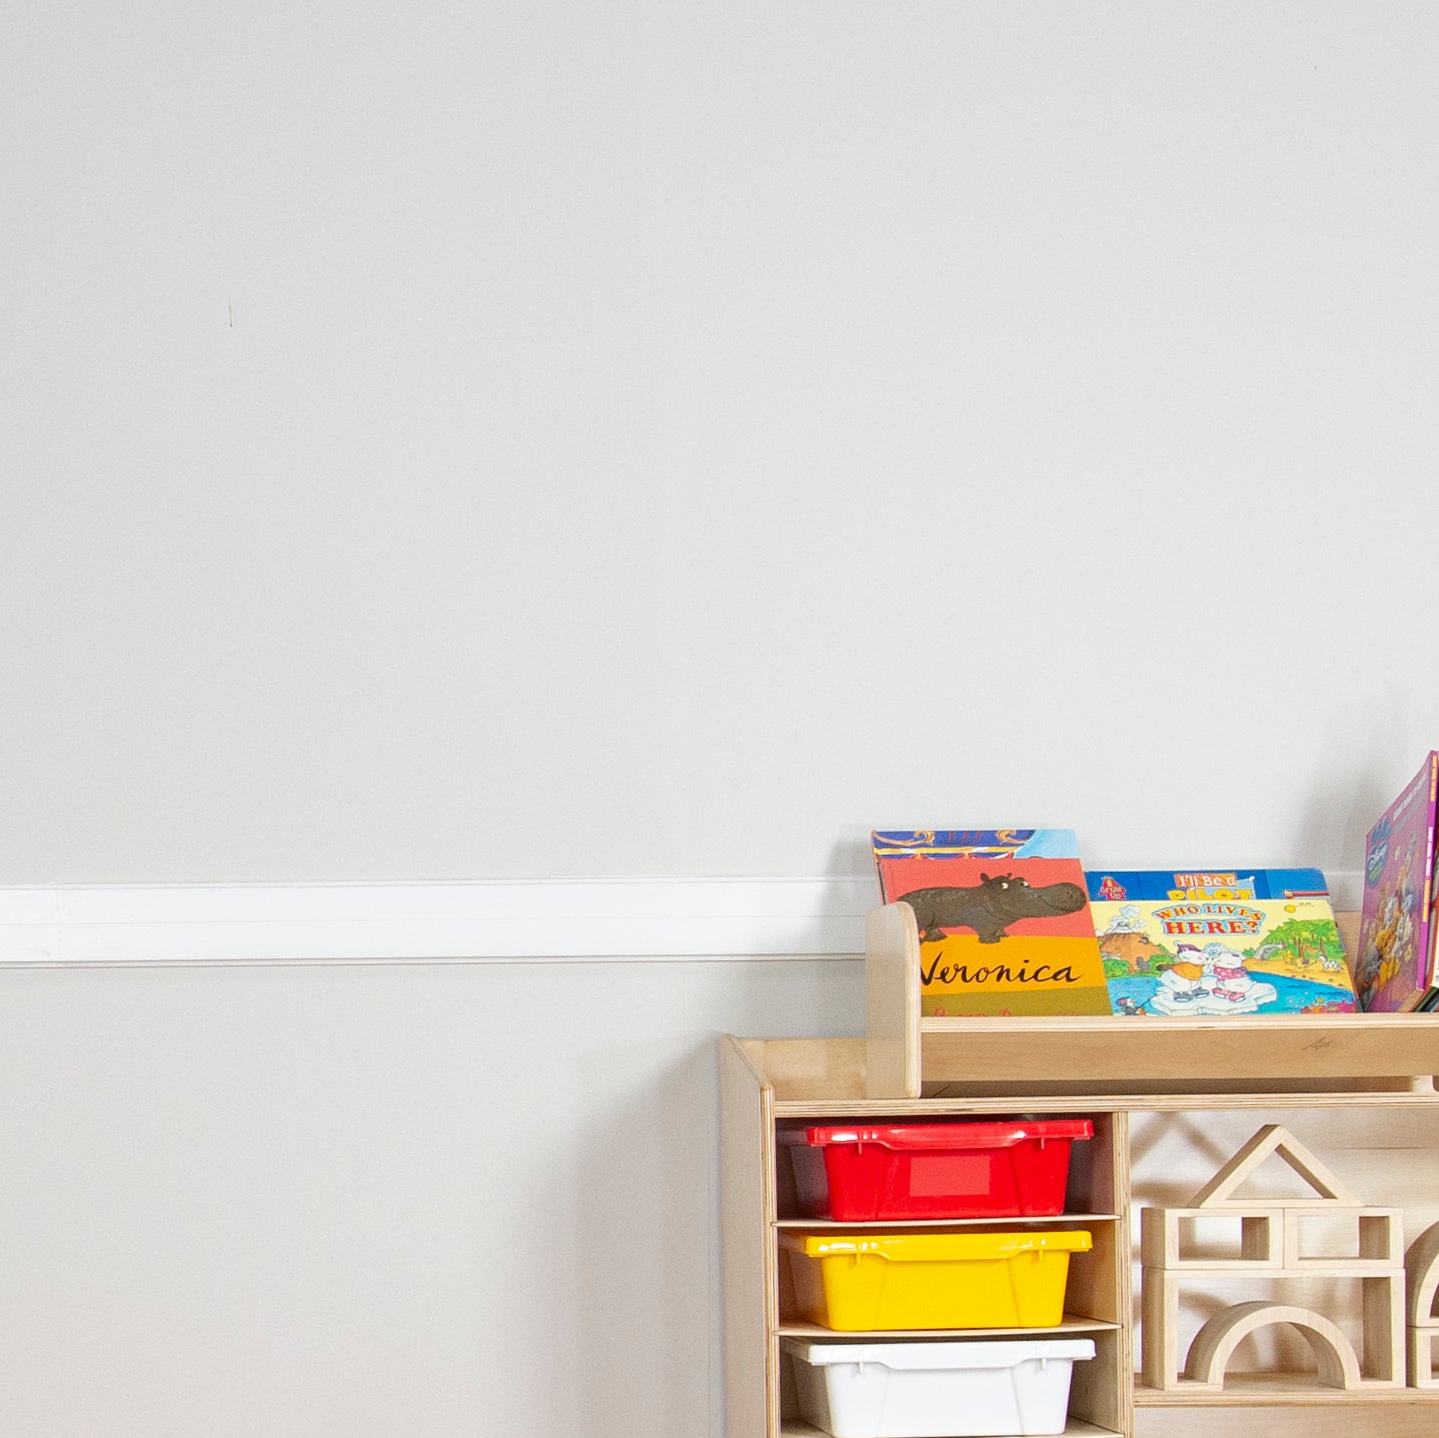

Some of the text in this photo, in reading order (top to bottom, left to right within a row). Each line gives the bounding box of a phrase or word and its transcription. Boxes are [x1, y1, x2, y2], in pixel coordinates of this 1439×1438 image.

[1179, 874, 1237, 887] I'll Be a
[1156, 904, 1263, 921] WHO LIVES
[1164, 920, 1261, 935] HERE?
[921, 951, 1085, 986] Veronica
